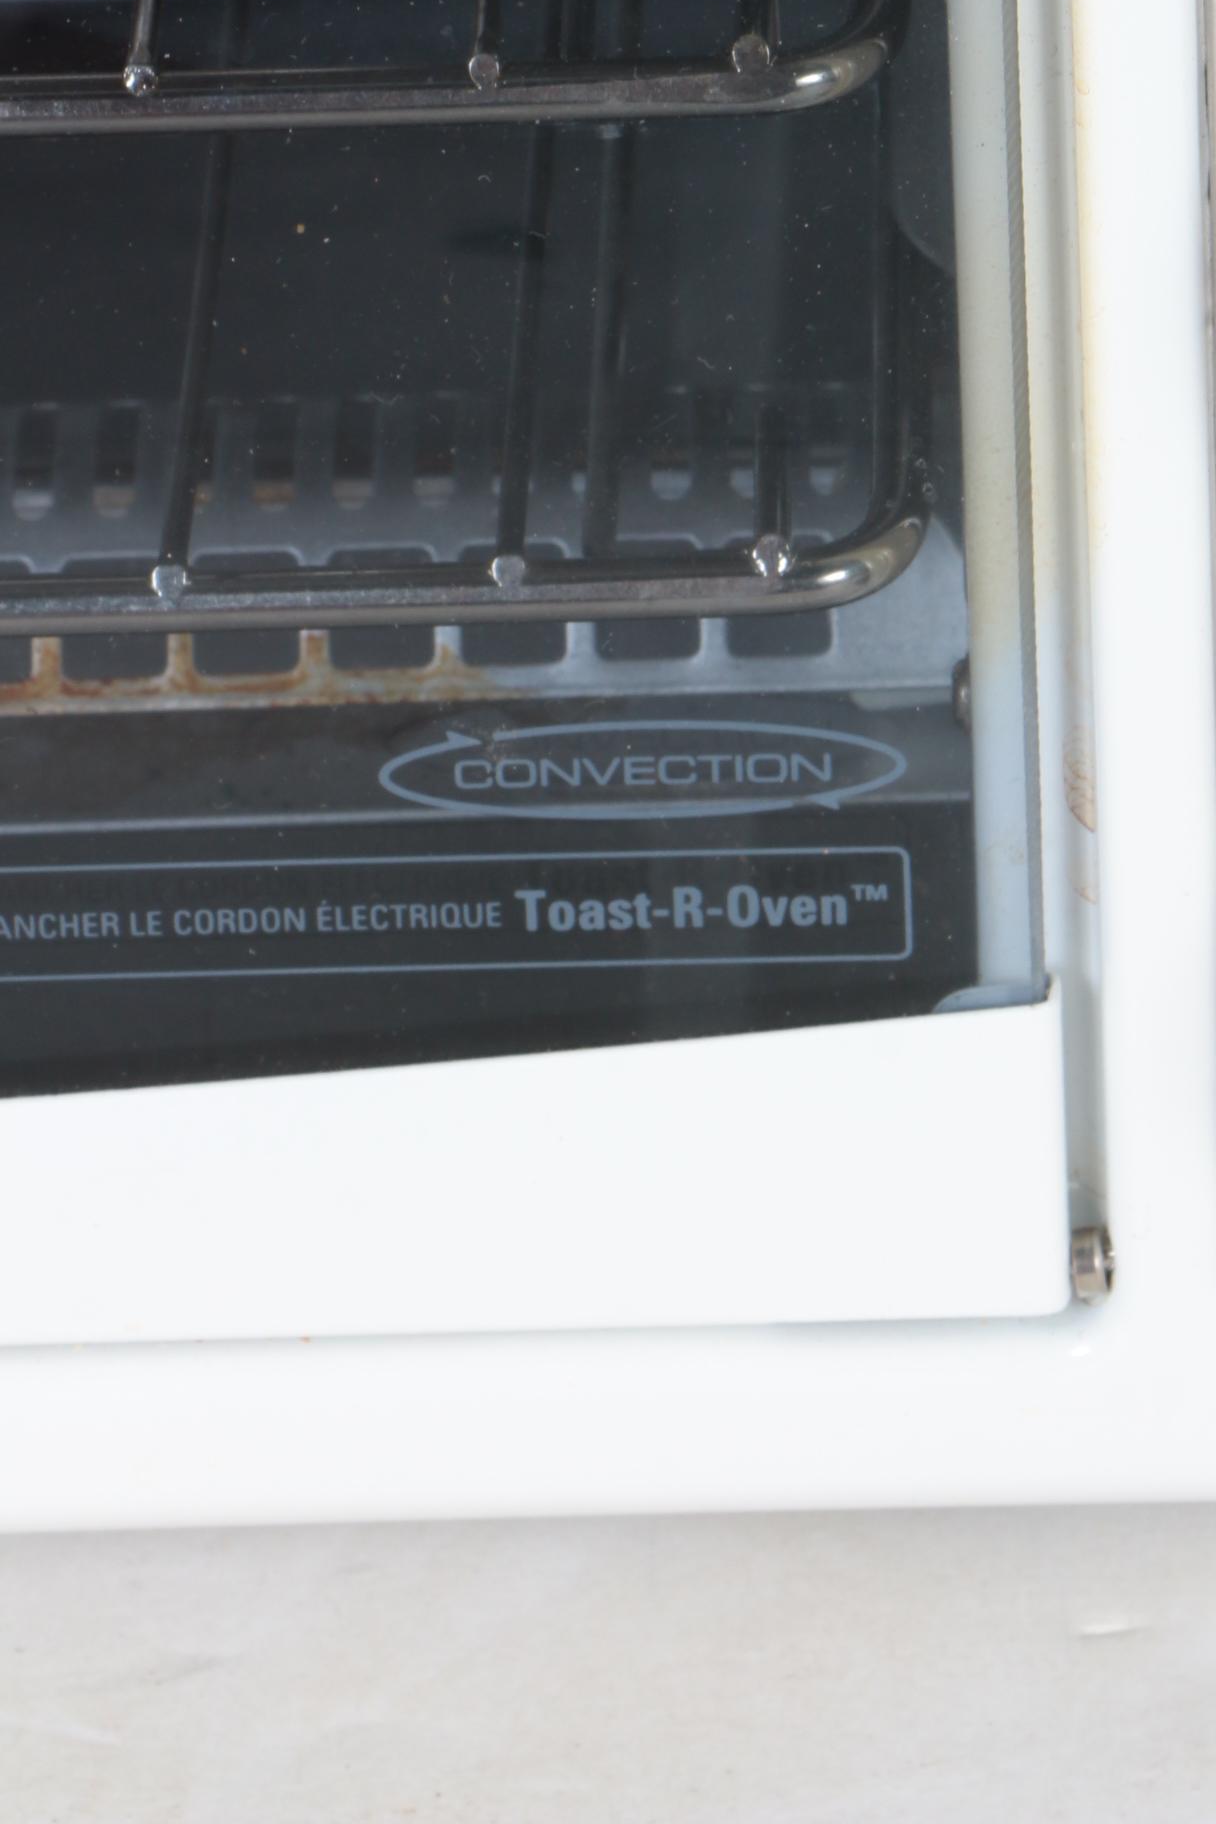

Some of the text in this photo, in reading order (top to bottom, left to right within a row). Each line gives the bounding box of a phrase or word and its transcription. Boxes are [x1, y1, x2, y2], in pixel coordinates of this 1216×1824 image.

[454, 753, 833, 790] CONVECTION
[130, 911, 161, 936] LE
[174, 907, 305, 935] CORDON
[316, 900, 501, 931] ÉLECTRIQUE
